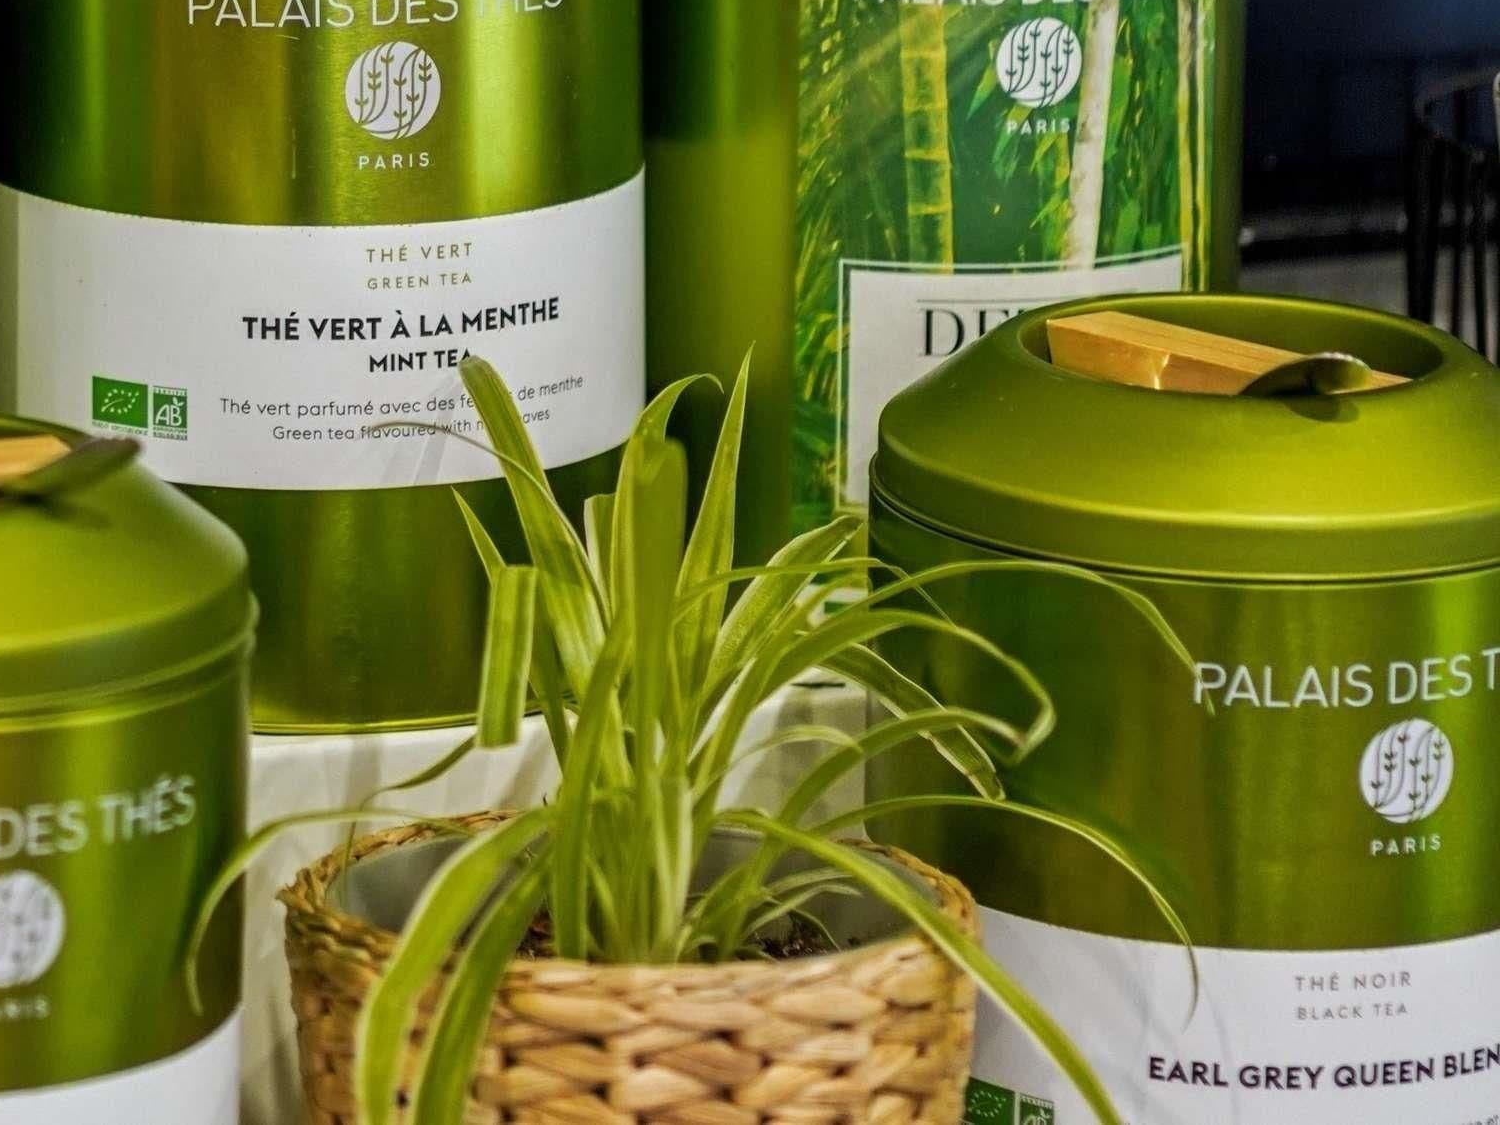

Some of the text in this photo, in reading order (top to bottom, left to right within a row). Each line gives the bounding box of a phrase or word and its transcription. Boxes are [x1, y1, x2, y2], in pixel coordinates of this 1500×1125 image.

[1005, 117, 1071, 136] PARIS
[358, 151, 431, 172] PARIS
[365, 242, 473, 263] THÉ VERT
[367, 272, 473, 291] GREEN TEA
[242, 296, 561, 341] THÉ VERT À LA MENTHE
[369, 351, 427, 373] MINT
[219, 397, 251, 415] Thé
[256, 401, 292, 416] vert
[297, 399, 374, 419] parfumé
[379, 400, 421, 416] avec
[426, 395, 456, 413] des
[517, 383, 536, 402] de
[539, 374, 584, 397] menthe
[154, 403, 183, 427] AB
[272, 425, 323, 441] Green
[328, 427, 355, 441] tea
[360, 420, 437, 440] flavoured
[442, 420, 473, 436] with
[1192, 661, 1374, 708] PALAIS
[1387, 654, 1474, 705] DES
[95, 774, 197, 846] THÉS
[1370, 833, 1443, 857] PARIS
[1295, 971, 1412, 994] THÉ NOIR
[1296, 1002, 1409, 1021] BLACK TEA
[1148, 1055, 1229, 1088] EARL
[1238, 1065, 1325, 1090] GREY
[1333, 1057, 1435, 1089] QUEEN
